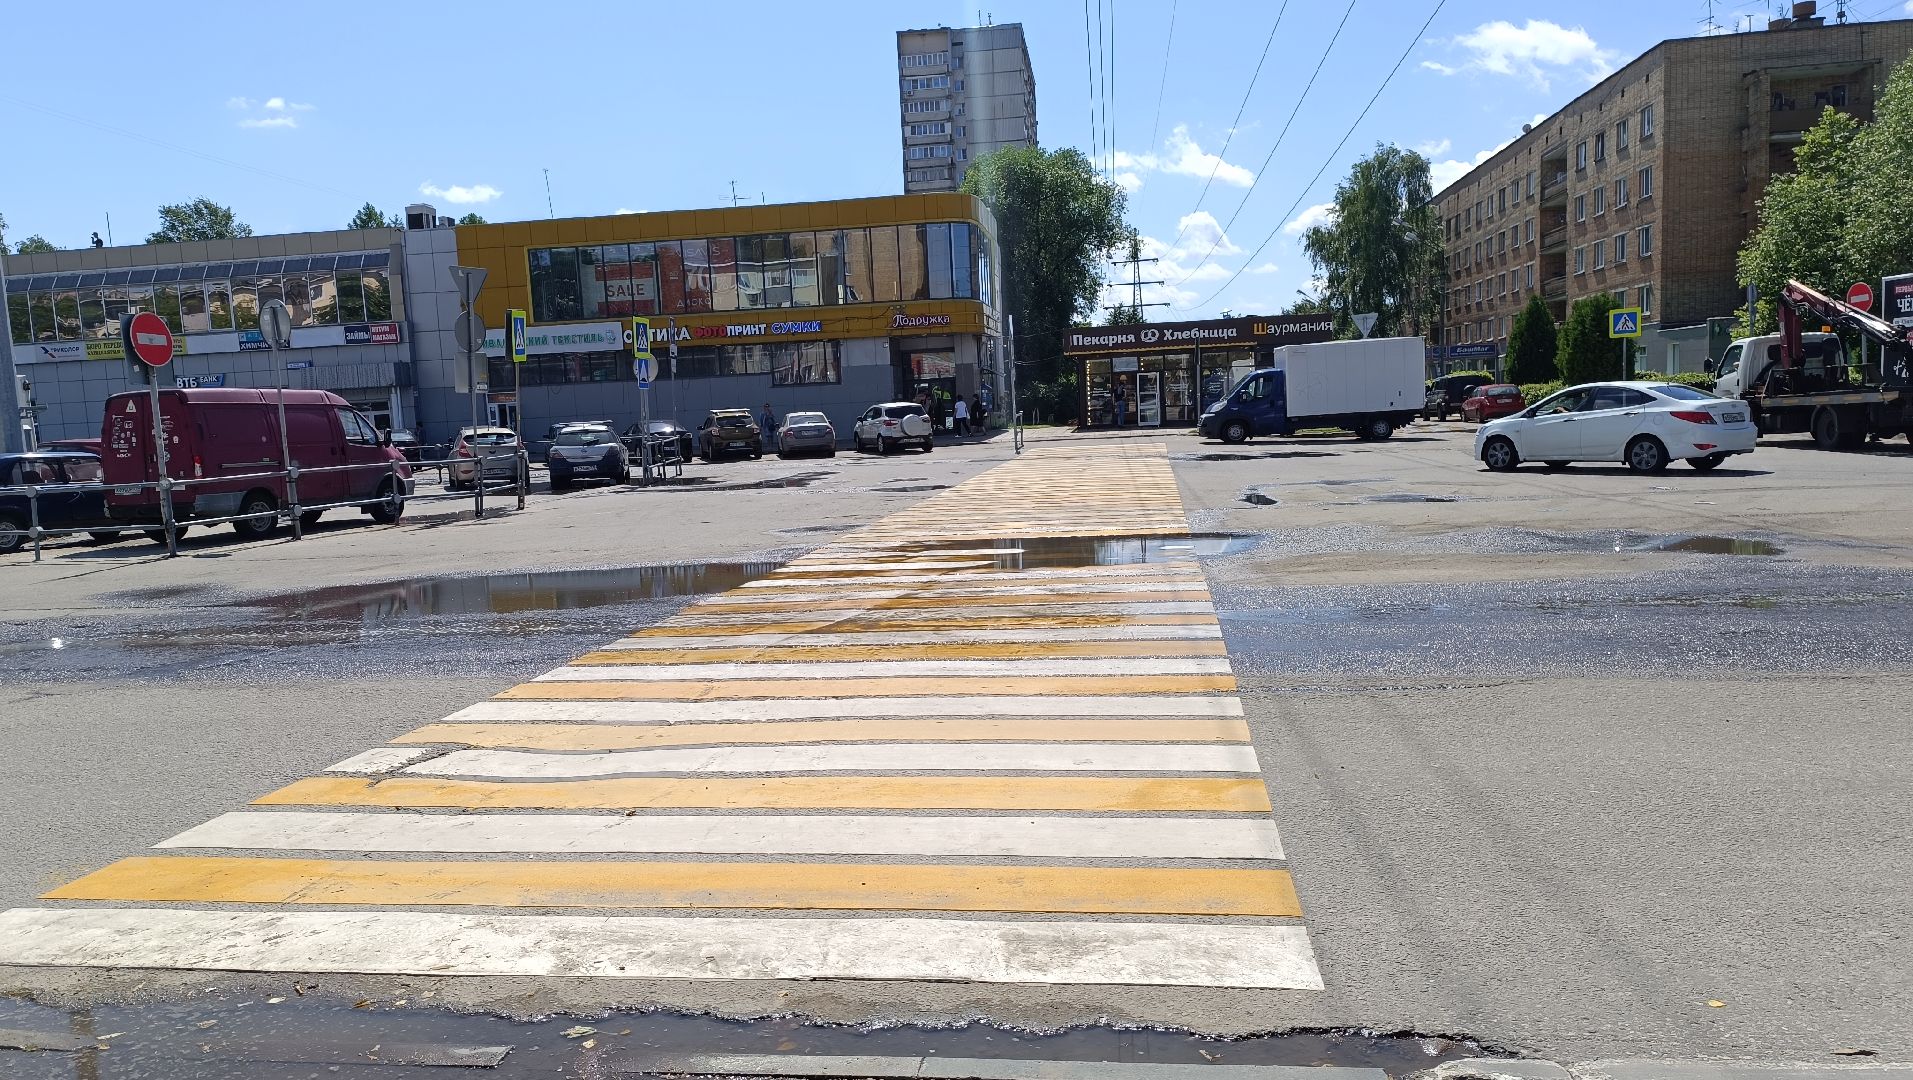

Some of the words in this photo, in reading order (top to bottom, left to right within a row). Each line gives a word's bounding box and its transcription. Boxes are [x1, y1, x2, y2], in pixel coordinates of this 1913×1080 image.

[606, 283, 645, 298] SALE
[771, 321, 822, 334] СУМКИ
[893, 314, 950, 328] Подружка
[1253, 320, 1333, 335] Шаурмания
[346, 331, 370, 341] ЗАЙМЫ
[551, 332, 604, 347] ТЕКСТИЛЬ
[1073, 331, 1136, 347] Пекарня
[1163, 327, 1238, 342] Хлебница
[176, 377, 198, 388] ВТБ
